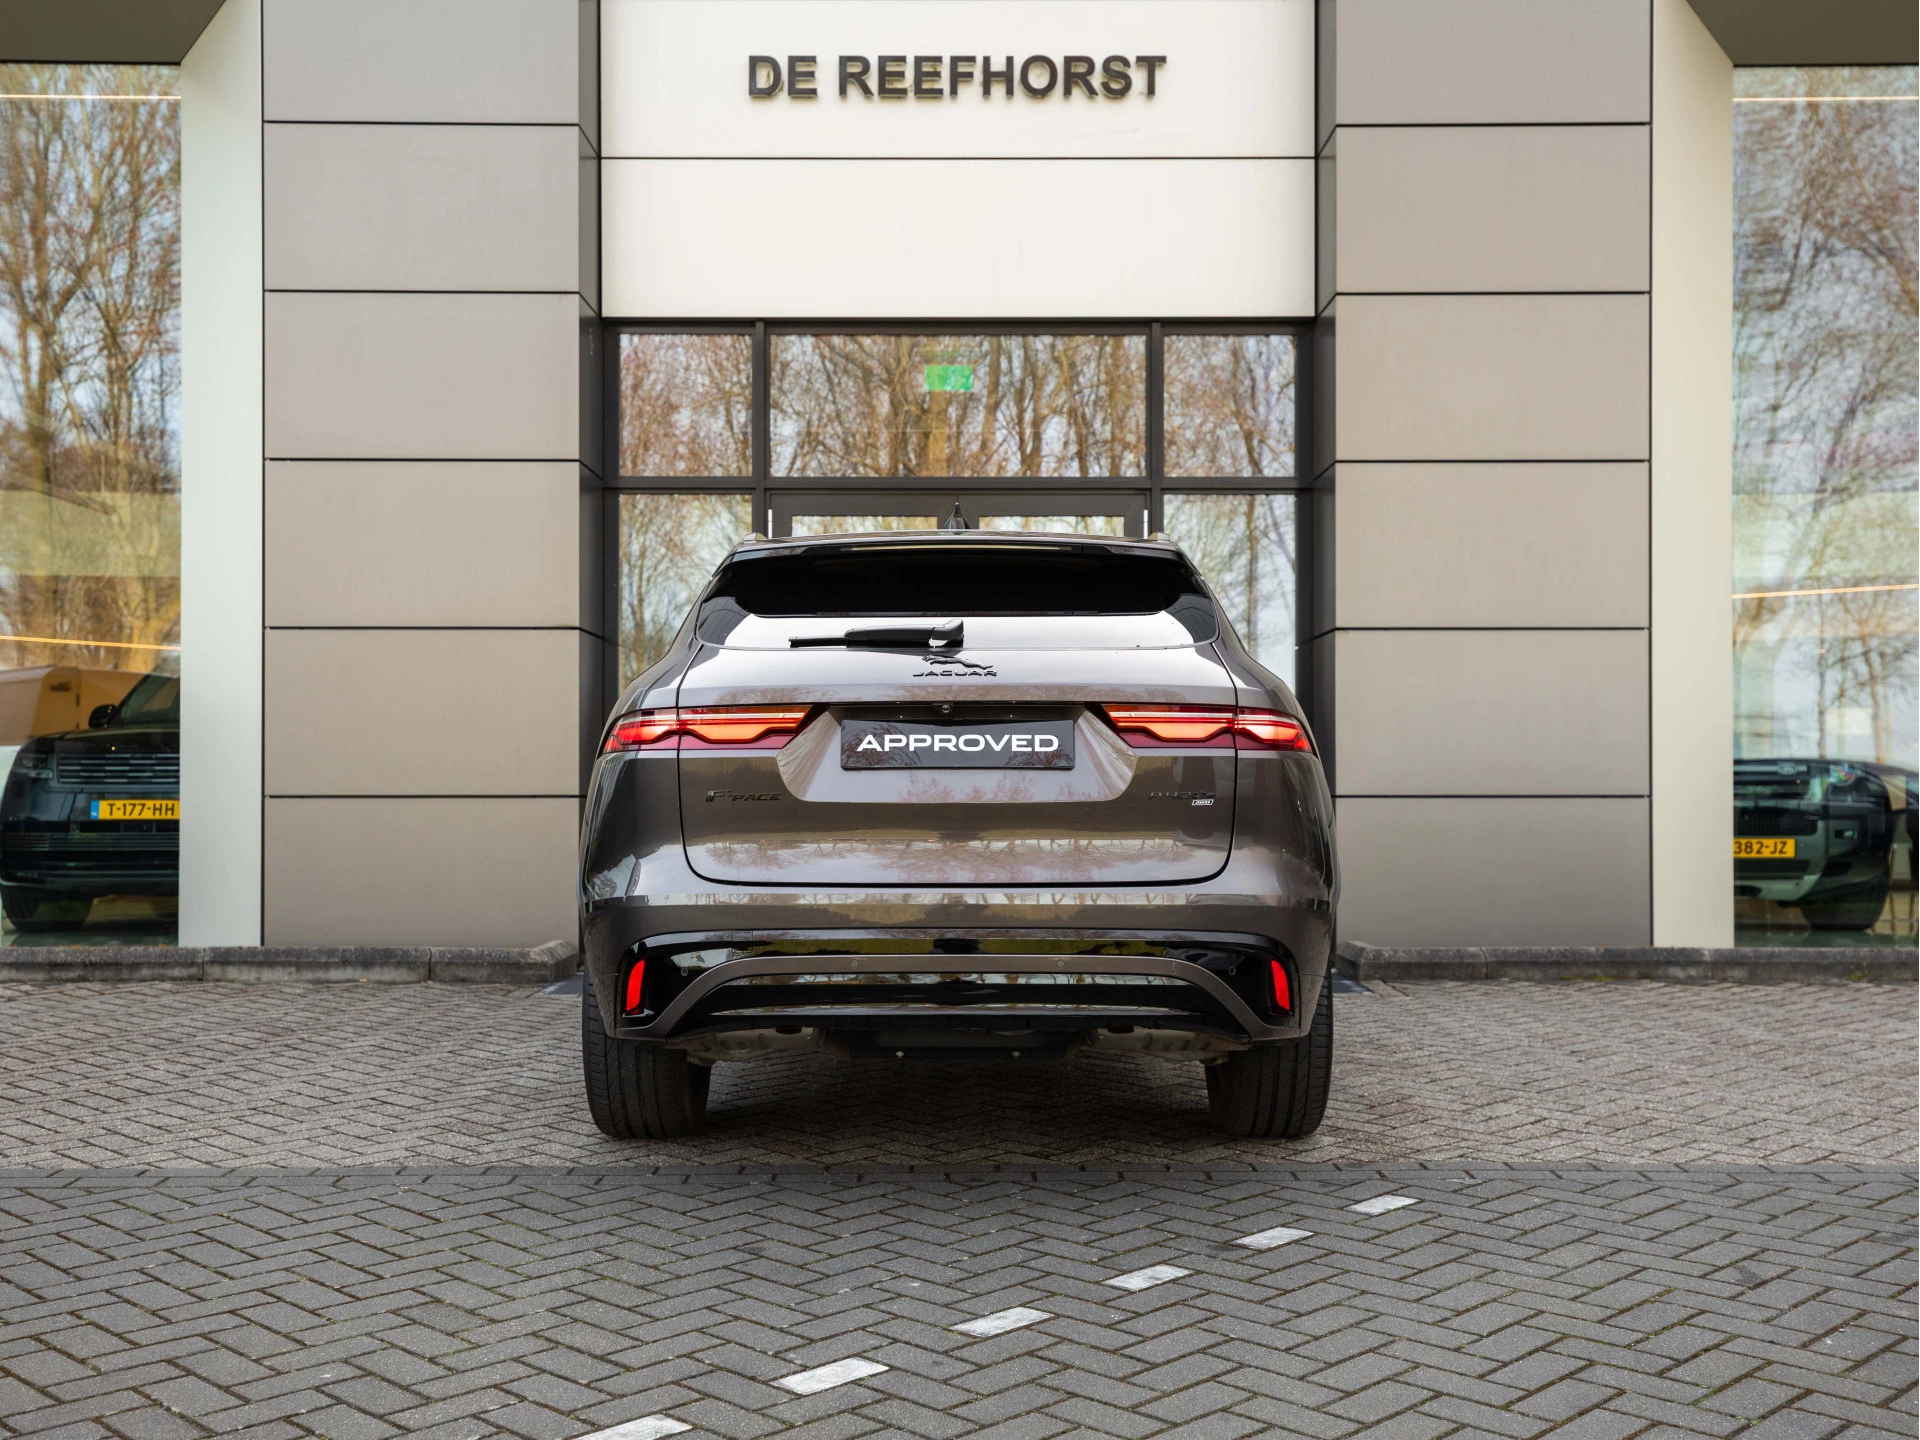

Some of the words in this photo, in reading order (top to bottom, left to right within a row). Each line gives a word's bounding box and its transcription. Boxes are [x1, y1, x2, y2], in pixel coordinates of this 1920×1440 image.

[749, 55, 818, 97] DE
[839, 55, 1168, 98] REEFHORST
[856, 734, 1060, 752] APPROVED
[107, 803, 175, 817] T-177-HH
